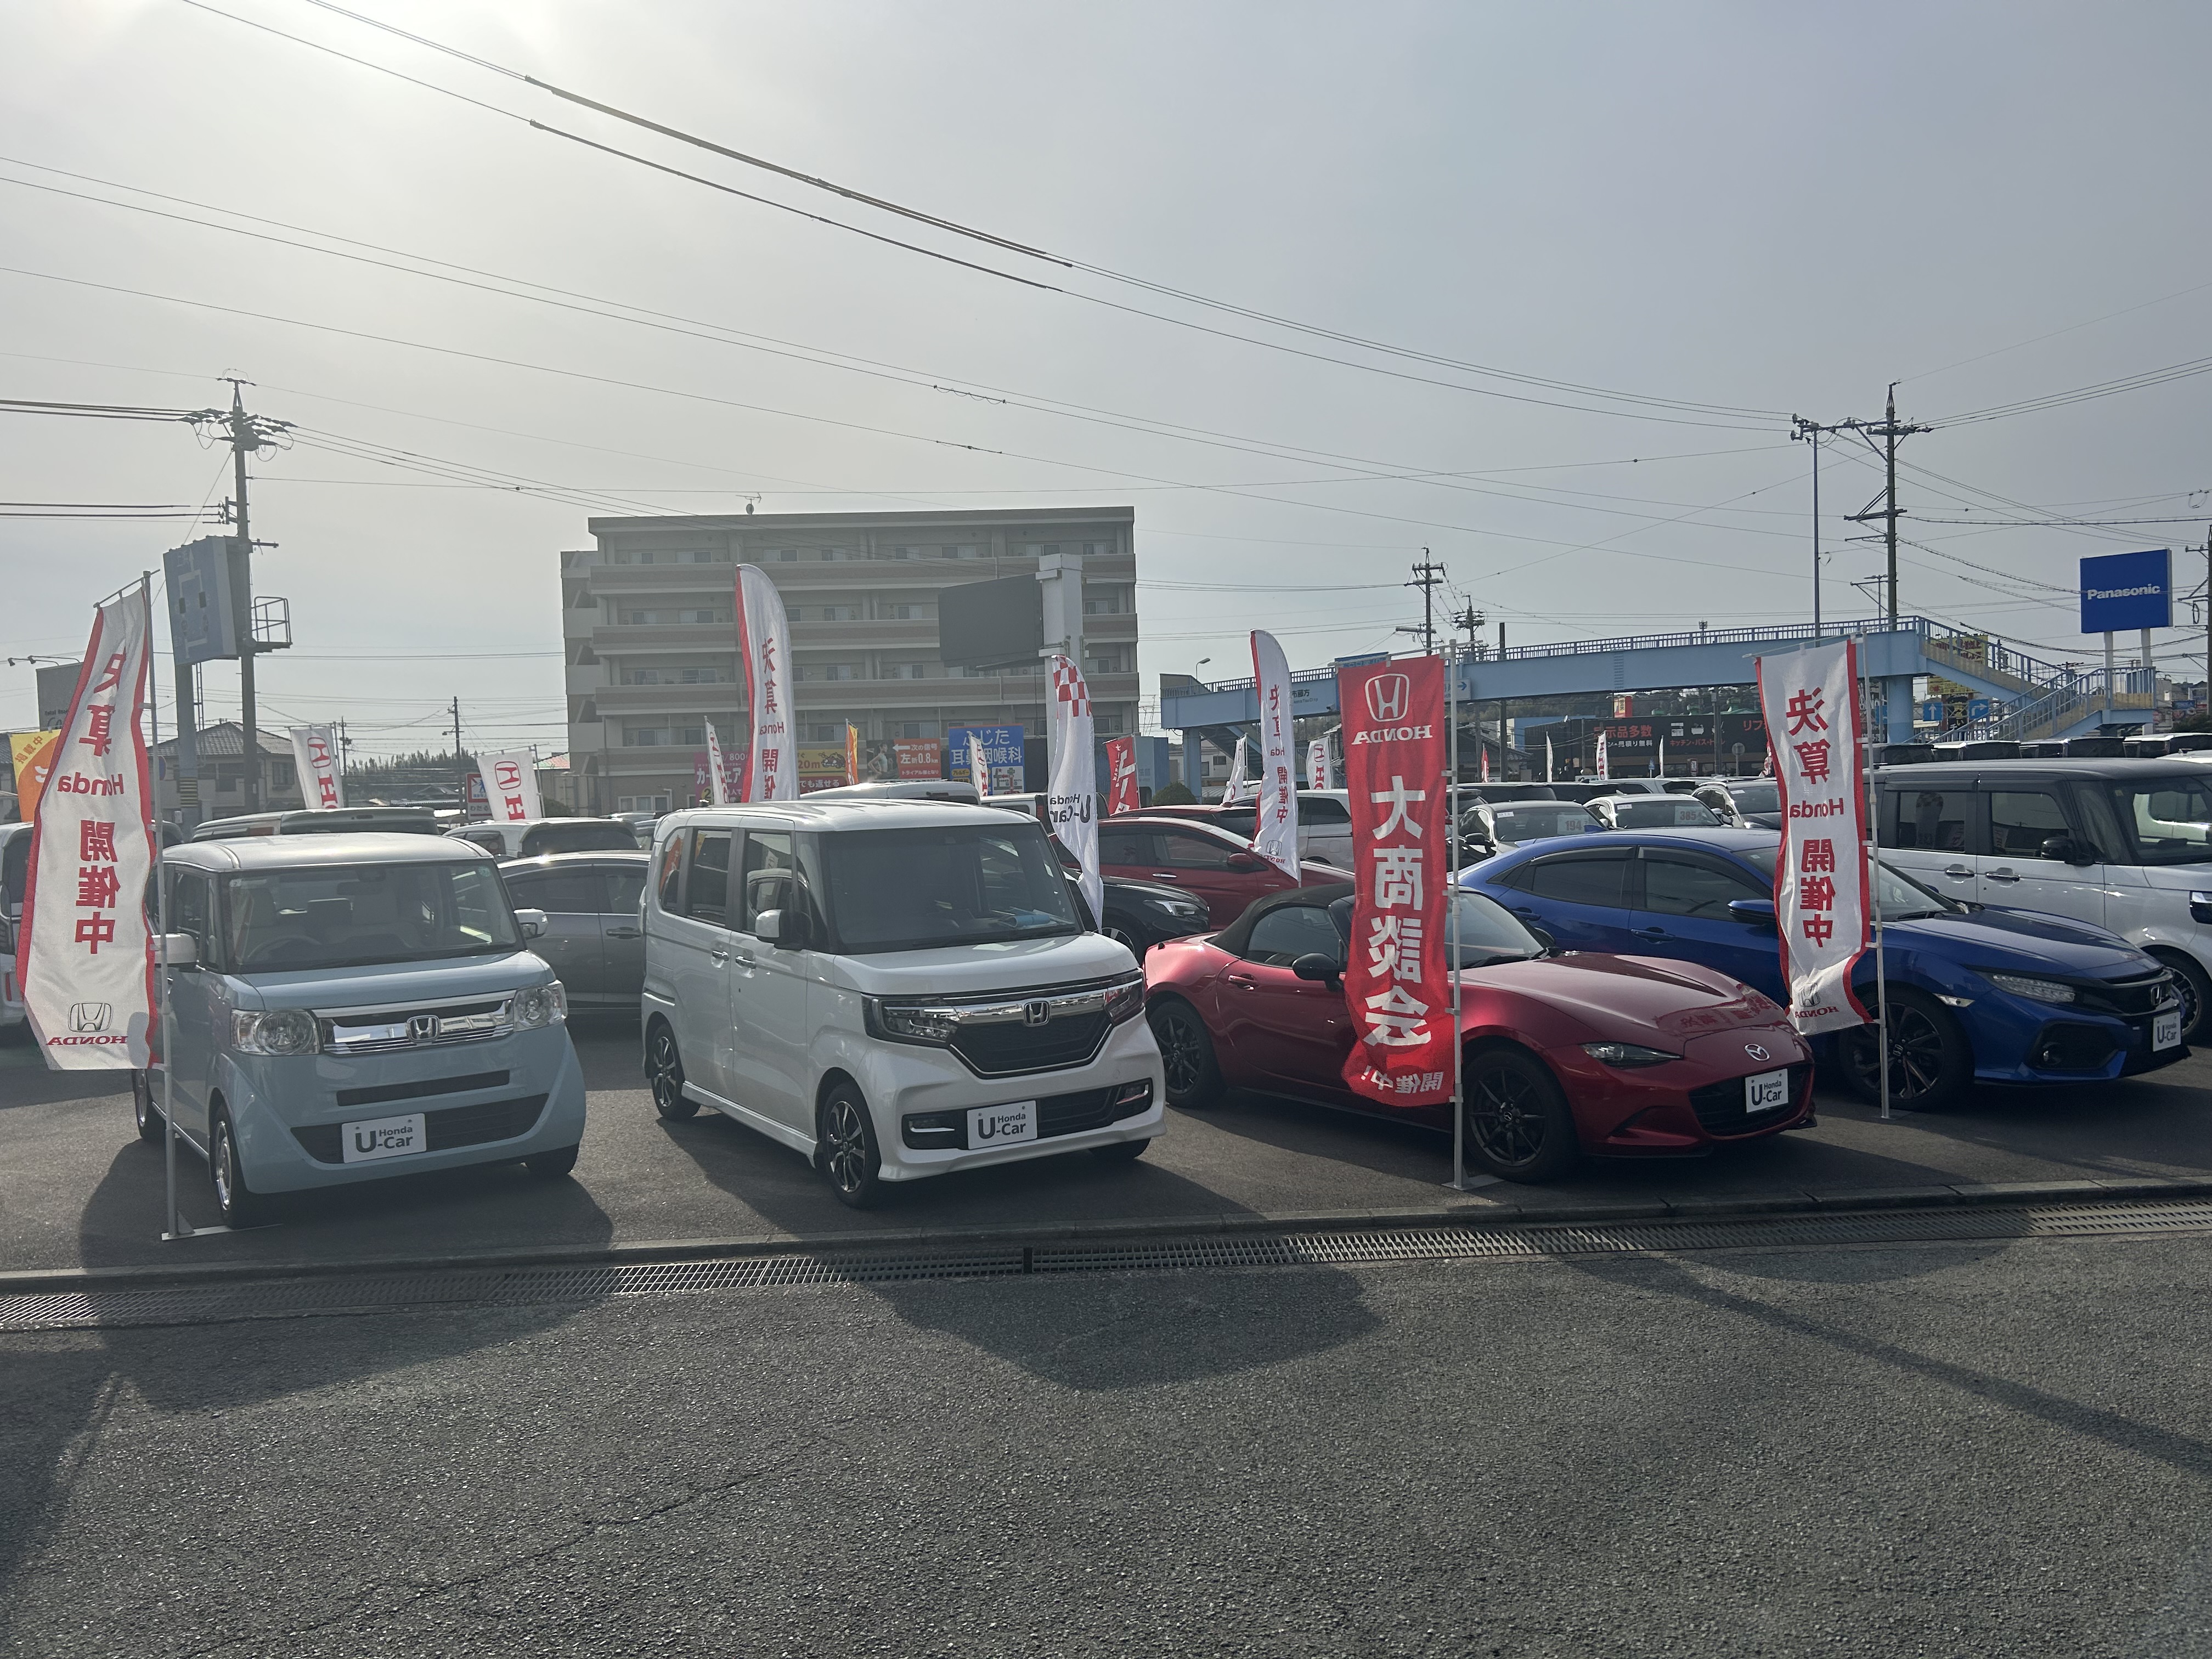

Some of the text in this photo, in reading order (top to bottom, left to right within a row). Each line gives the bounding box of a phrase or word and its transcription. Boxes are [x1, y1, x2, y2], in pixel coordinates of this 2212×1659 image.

[2087, 583, 2160, 600] Panasonic
[1743, 719, 1766, 731] リフ
[1669, 738, 1726, 747] キッチン・バス・トレ
[318, 774, 338, 809] H
[1764, 1080, 1782, 1090] Honda
[1751, 1084, 1782, 1106] U-Car
[997, 1113, 1026, 1123] Honda
[379, 1126, 413, 1137] Honda
[978, 1116, 1026, 1139] U-Car
[355, 1130, 413, 1153] U-Car
